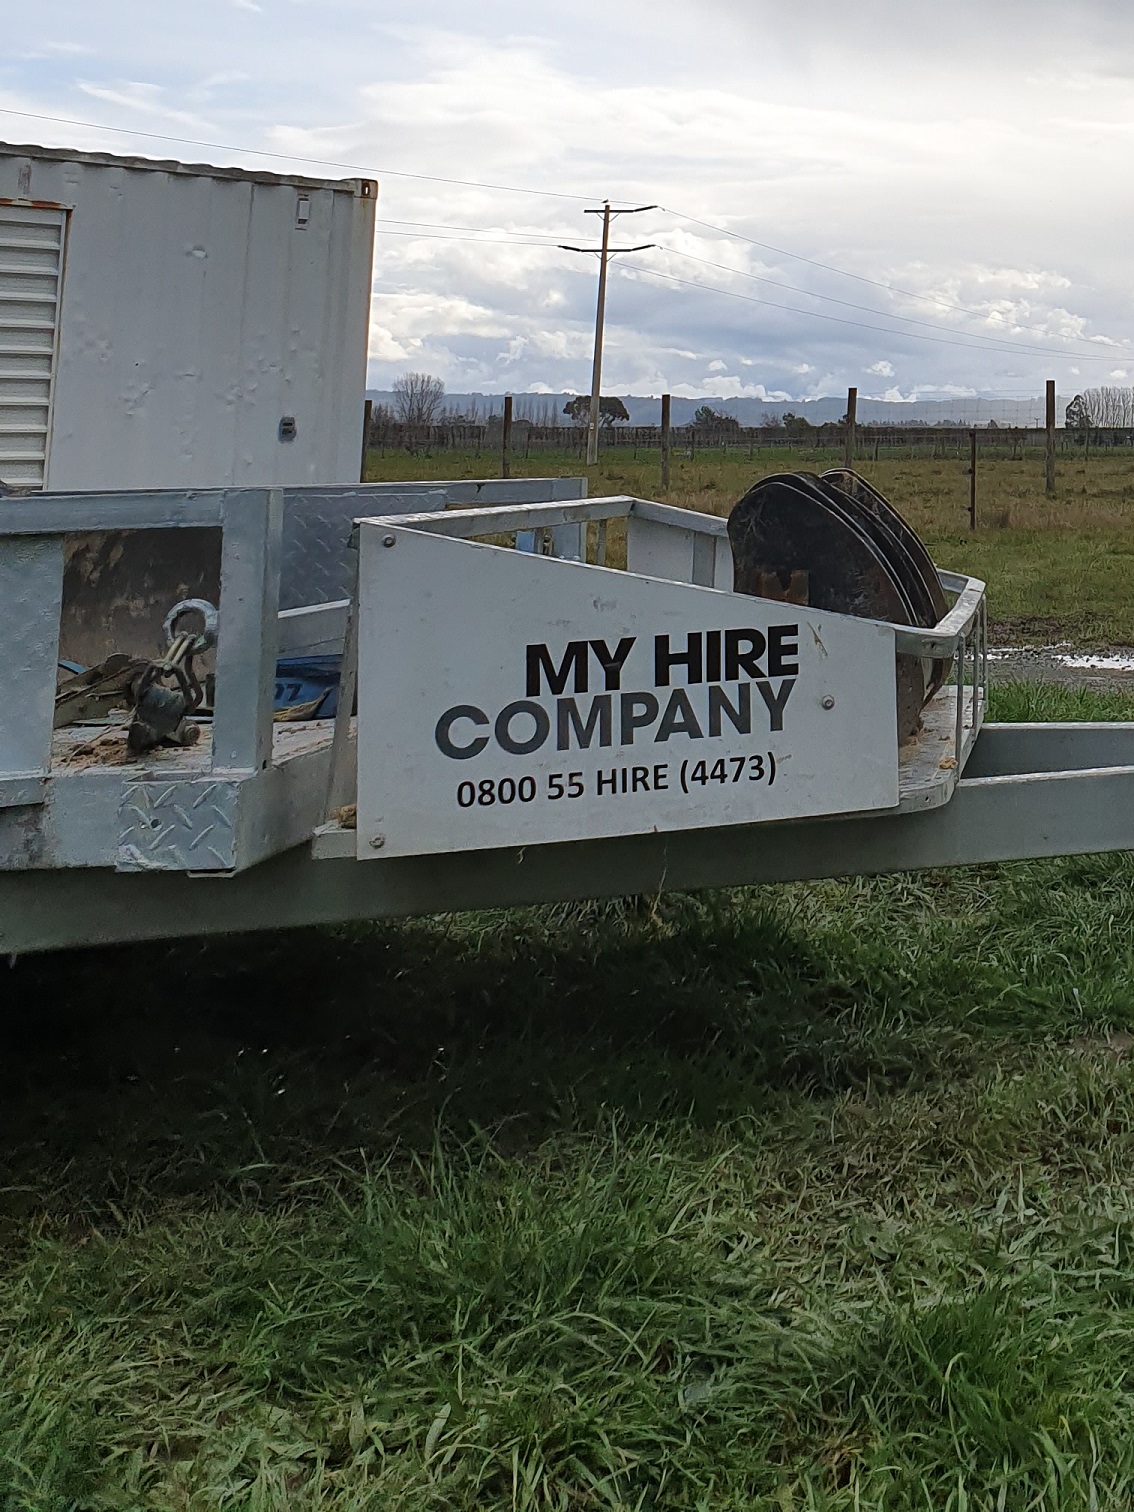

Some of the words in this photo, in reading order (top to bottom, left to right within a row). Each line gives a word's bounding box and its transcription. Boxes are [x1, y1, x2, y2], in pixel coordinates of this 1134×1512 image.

[525, 637, 637, 698] MY
[654, 624, 799, 687] HIRE
[434, 678, 797, 760] COMPANY
[457, 775, 537, 808] 0800
[547, 771, 585, 800] 55
[597, 764, 669, 796] HIRE
[680, 751, 777, 794] (4473)
